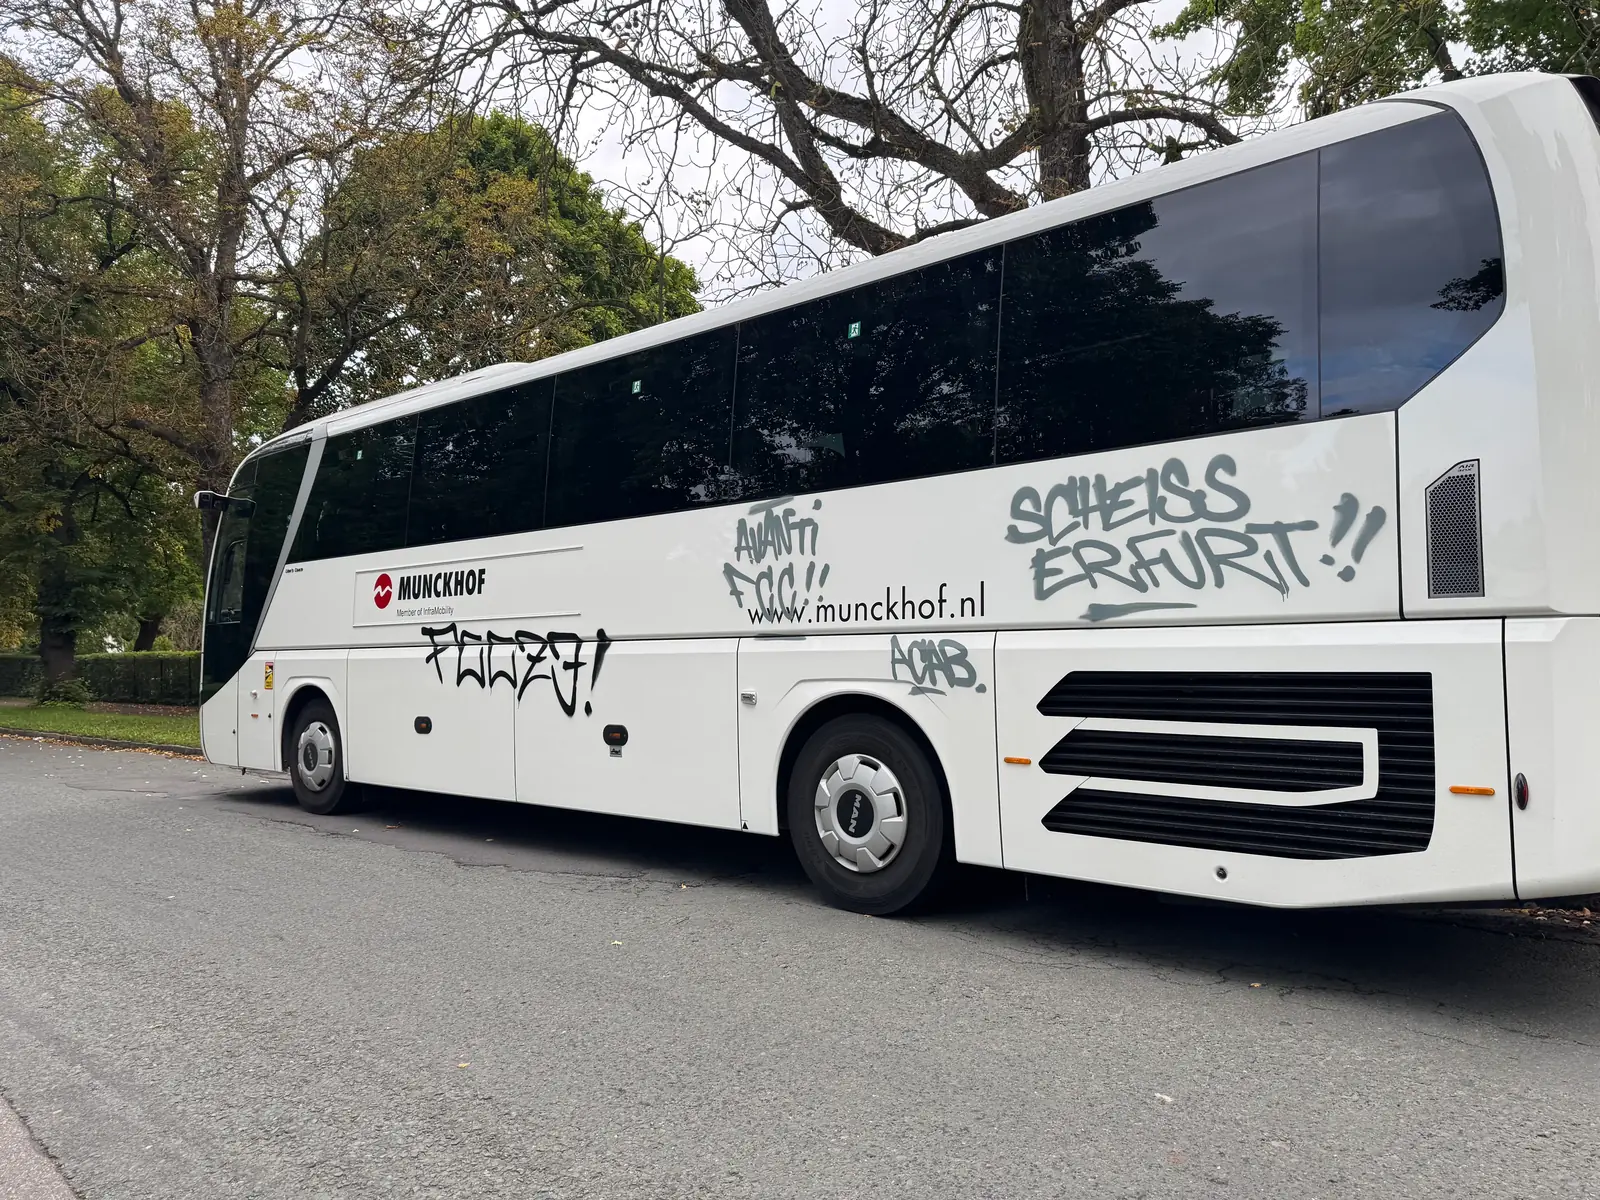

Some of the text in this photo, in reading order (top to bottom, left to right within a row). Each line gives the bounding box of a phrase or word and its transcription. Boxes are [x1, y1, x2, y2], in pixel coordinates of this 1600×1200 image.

[1005, 453, 1251, 546] SCHEISS
[398, 568, 486, 601] MUNCKHOF
[748, 580, 985, 625] www.munckhof.nl
[396, 609, 417, 617] Member
[848, 793, 862, 834] MAN
